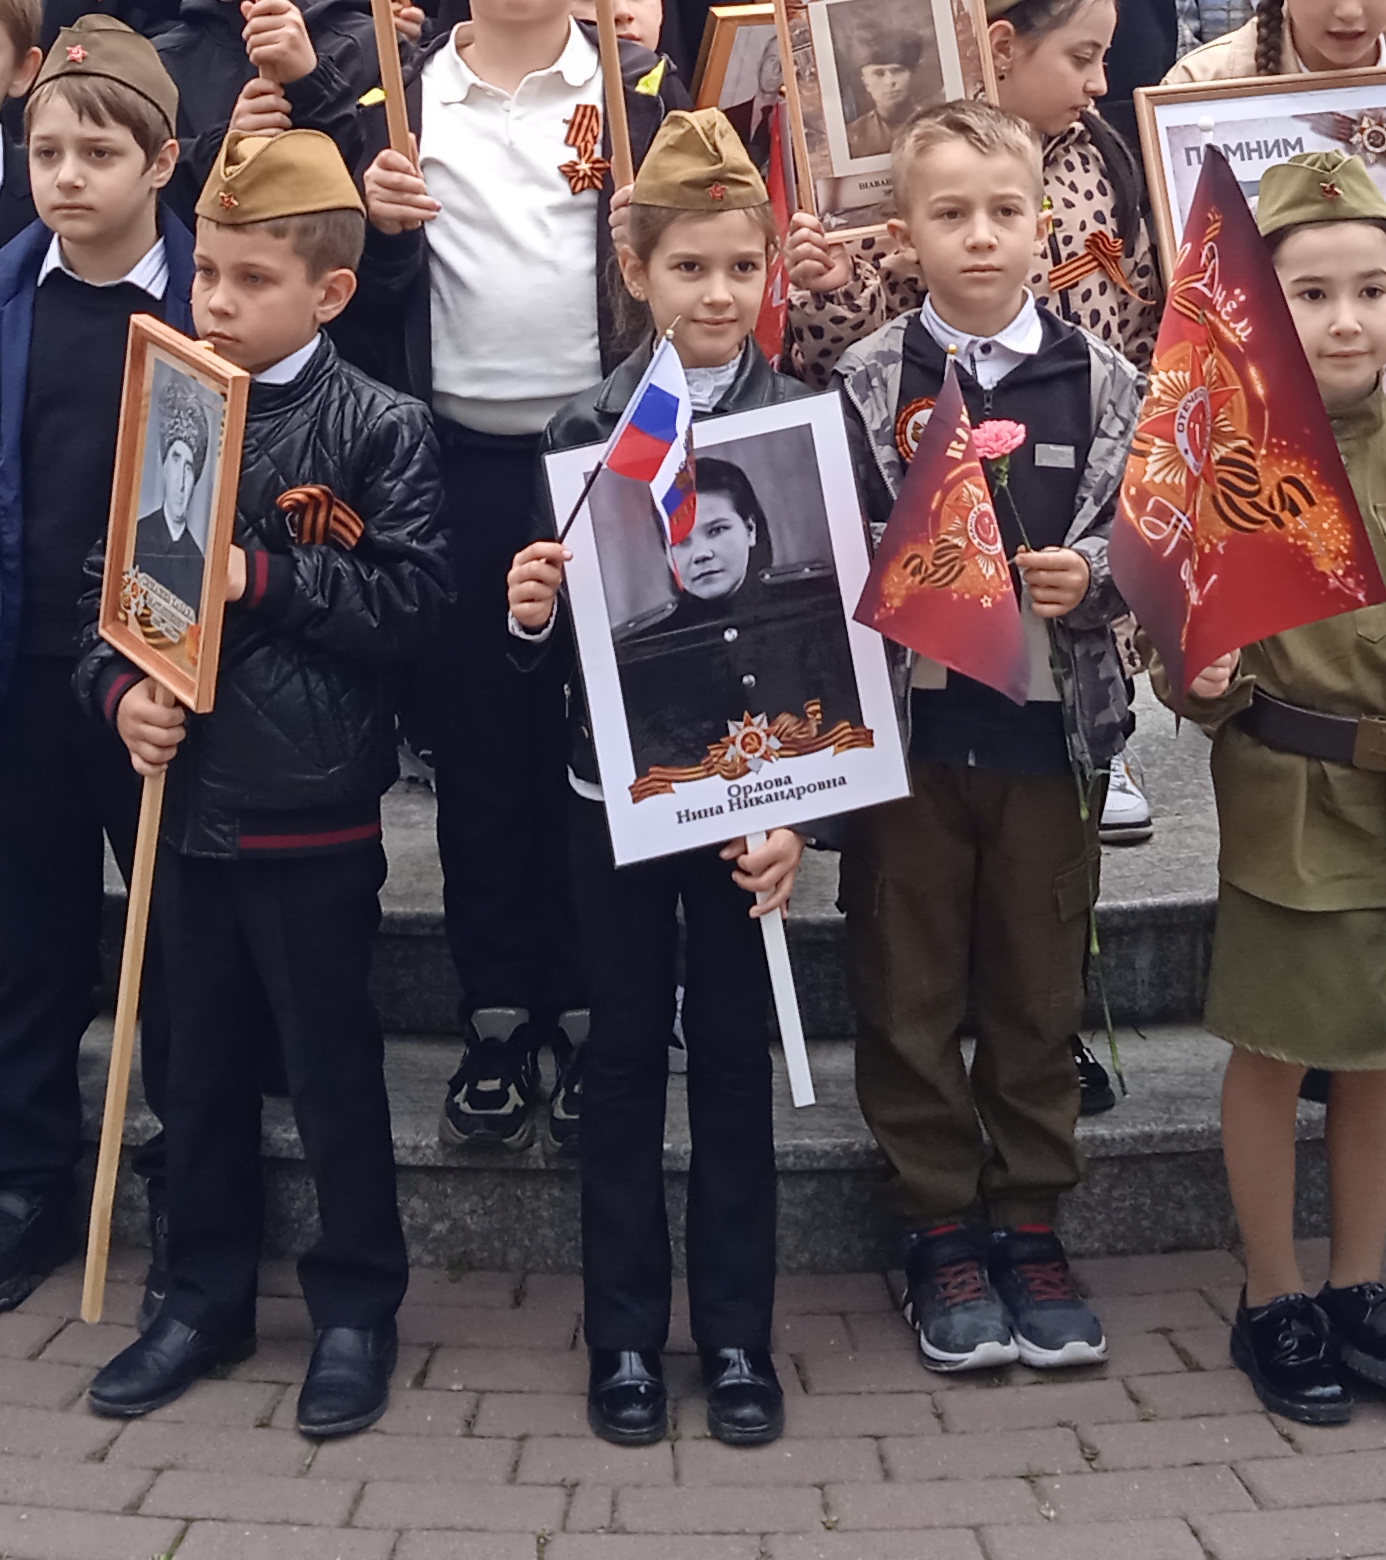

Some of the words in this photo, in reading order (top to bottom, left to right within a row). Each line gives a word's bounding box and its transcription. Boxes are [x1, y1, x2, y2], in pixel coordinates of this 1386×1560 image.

[1184, 136, 1305, 167] ПМНИМ
[676, 804, 724, 824] Нина
[727, 775, 848, 812] Никандровна
[726, 774, 793, 799] Орлова
